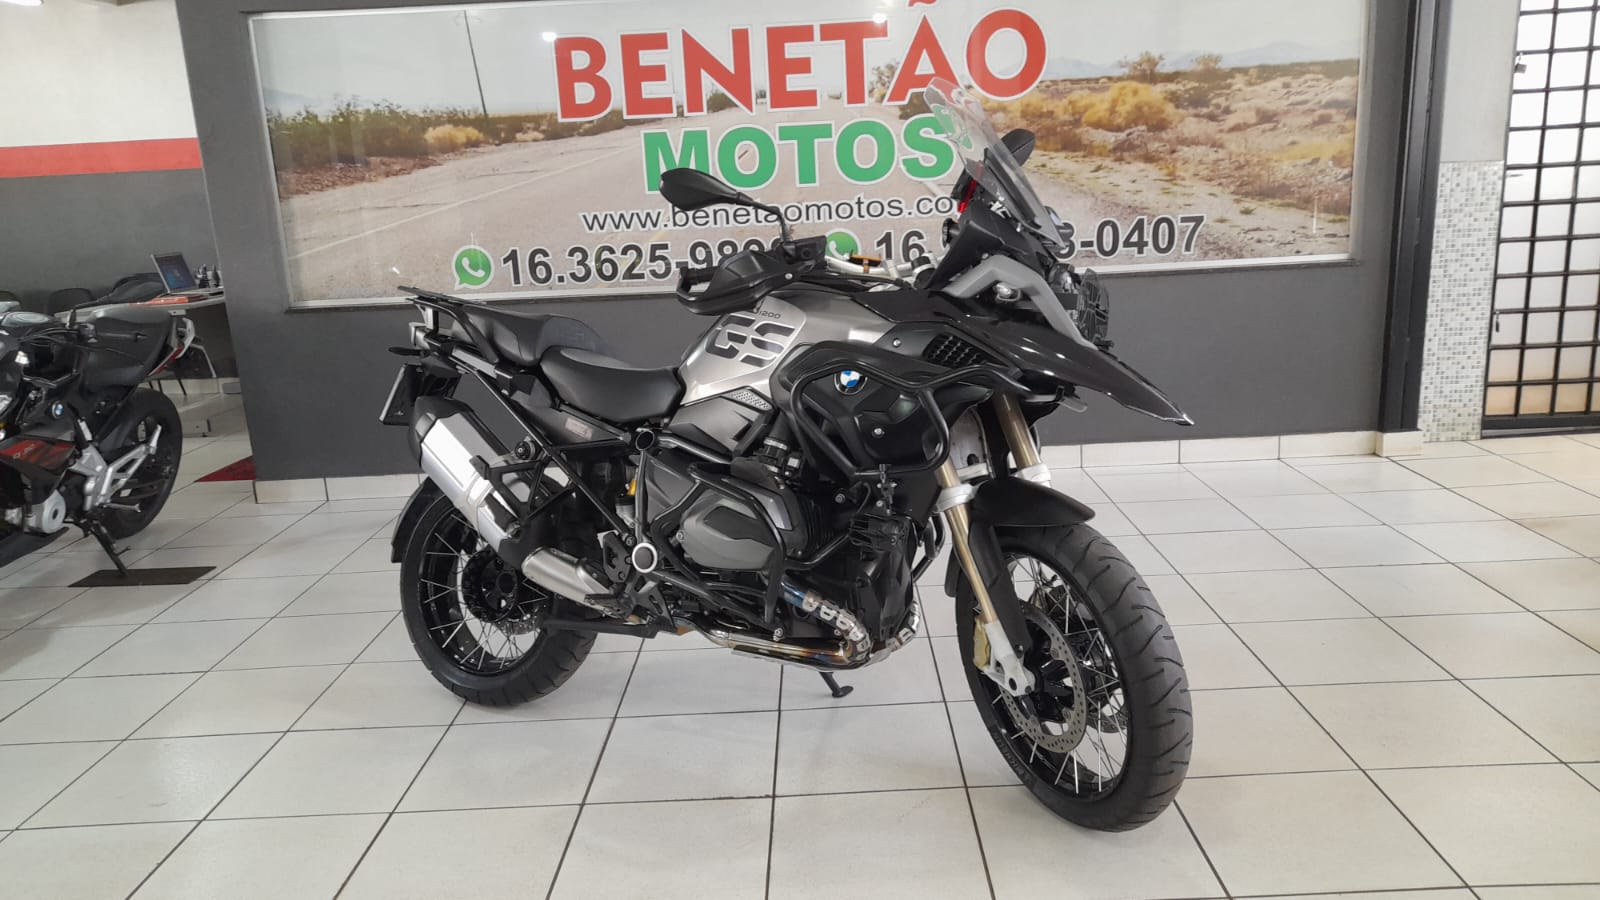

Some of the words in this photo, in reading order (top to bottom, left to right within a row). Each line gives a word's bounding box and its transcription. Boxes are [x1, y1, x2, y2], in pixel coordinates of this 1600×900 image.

[556, 1, 1047, 121] BENETÃO
[643, 114, 955, 191] MOTOS
[582, 196, 953, 231] www.benetaomotos.co
[705, 313, 796, 368] GS
